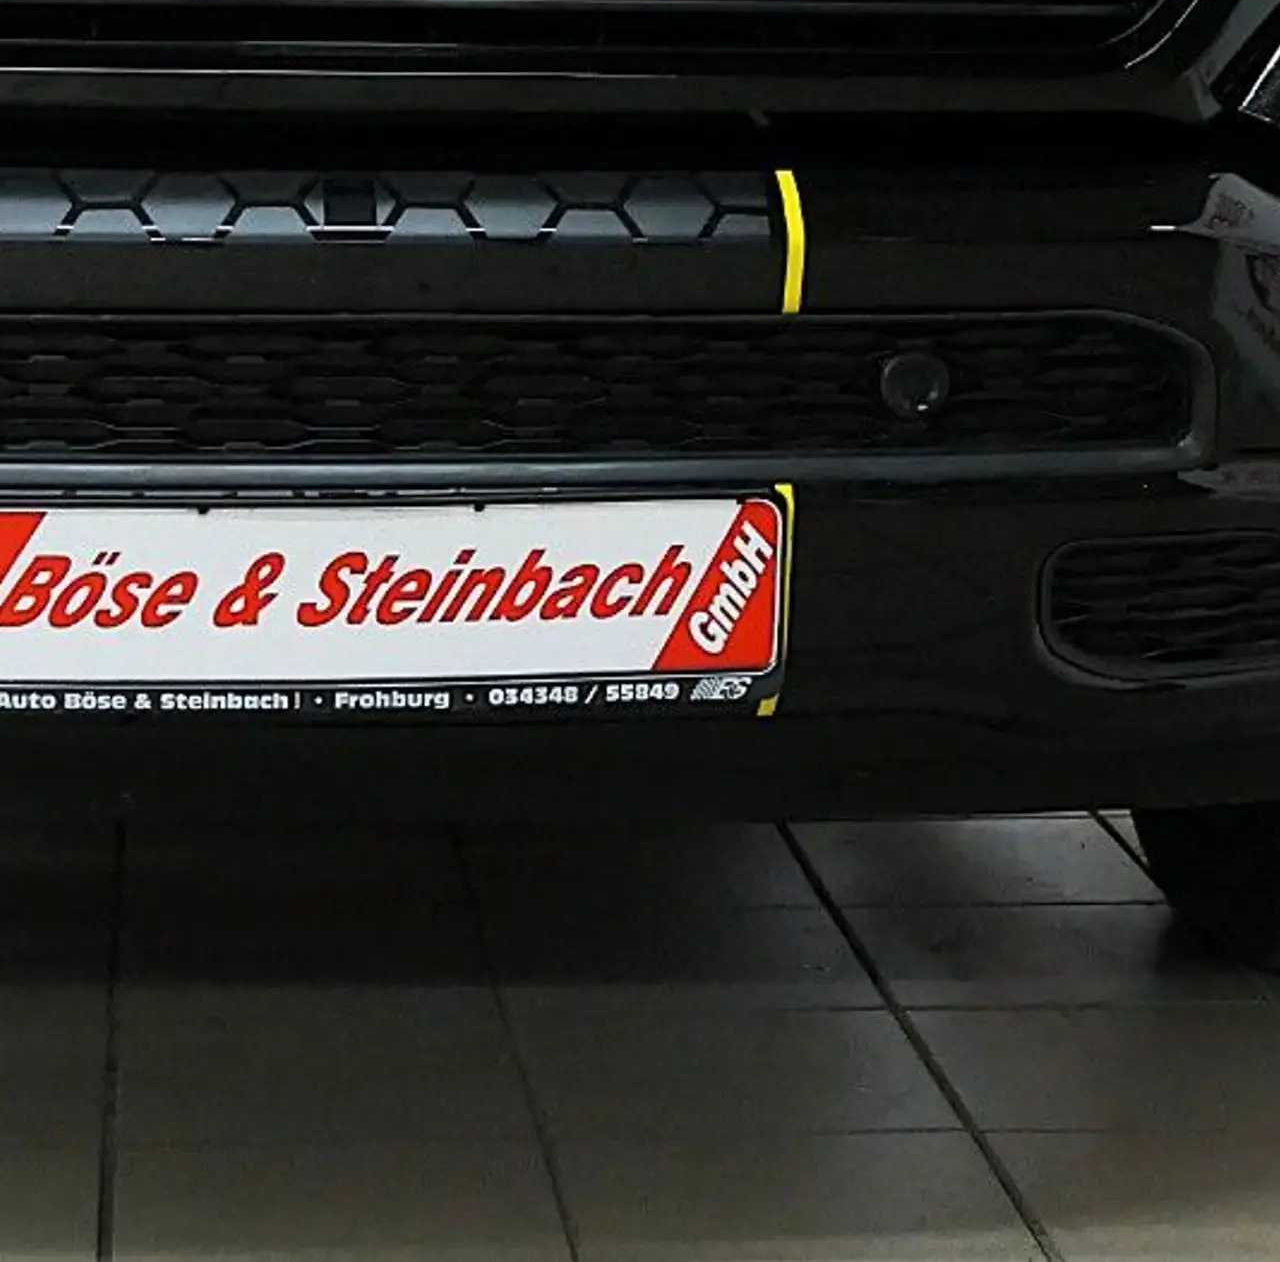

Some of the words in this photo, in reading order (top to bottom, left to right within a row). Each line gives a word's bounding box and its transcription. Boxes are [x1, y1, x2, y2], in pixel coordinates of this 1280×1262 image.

[212, 551, 288, 628] &
[297, 544, 693, 628] Steinbach
[687, 520, 774, 655] GmbH
[64, 691, 126, 710] Böse
[134, 694, 151, 710] &
[334, 691, 450, 709] Frohburg
[488, 687, 579, 705] 034348
[605, 683, 680, 701] 55849
